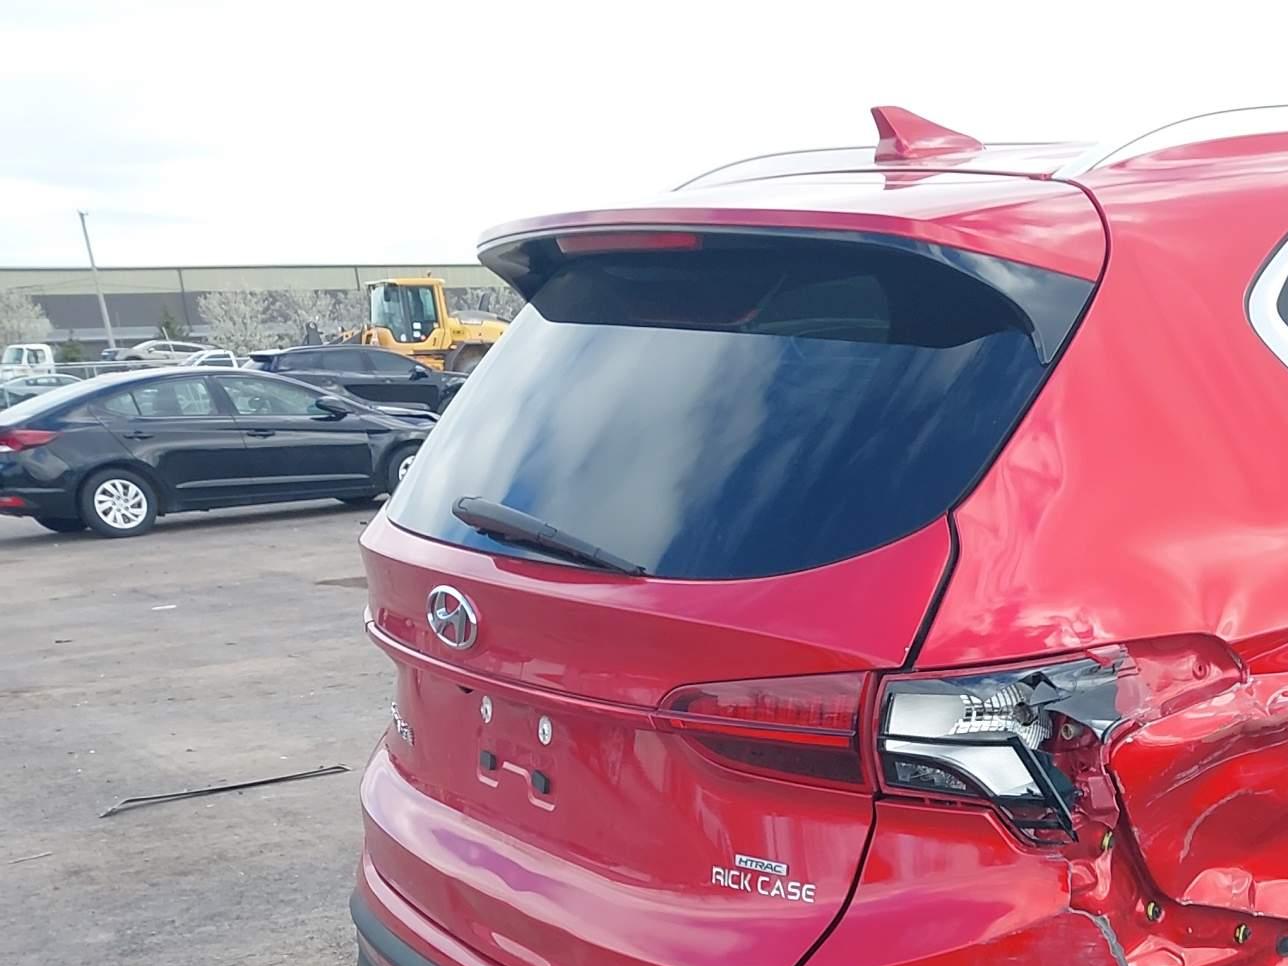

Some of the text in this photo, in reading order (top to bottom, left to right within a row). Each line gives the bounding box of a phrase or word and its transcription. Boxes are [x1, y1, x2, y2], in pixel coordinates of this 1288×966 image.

[738, 856, 784, 874] HTRAC
[711, 866, 817, 903] RICK CASE
